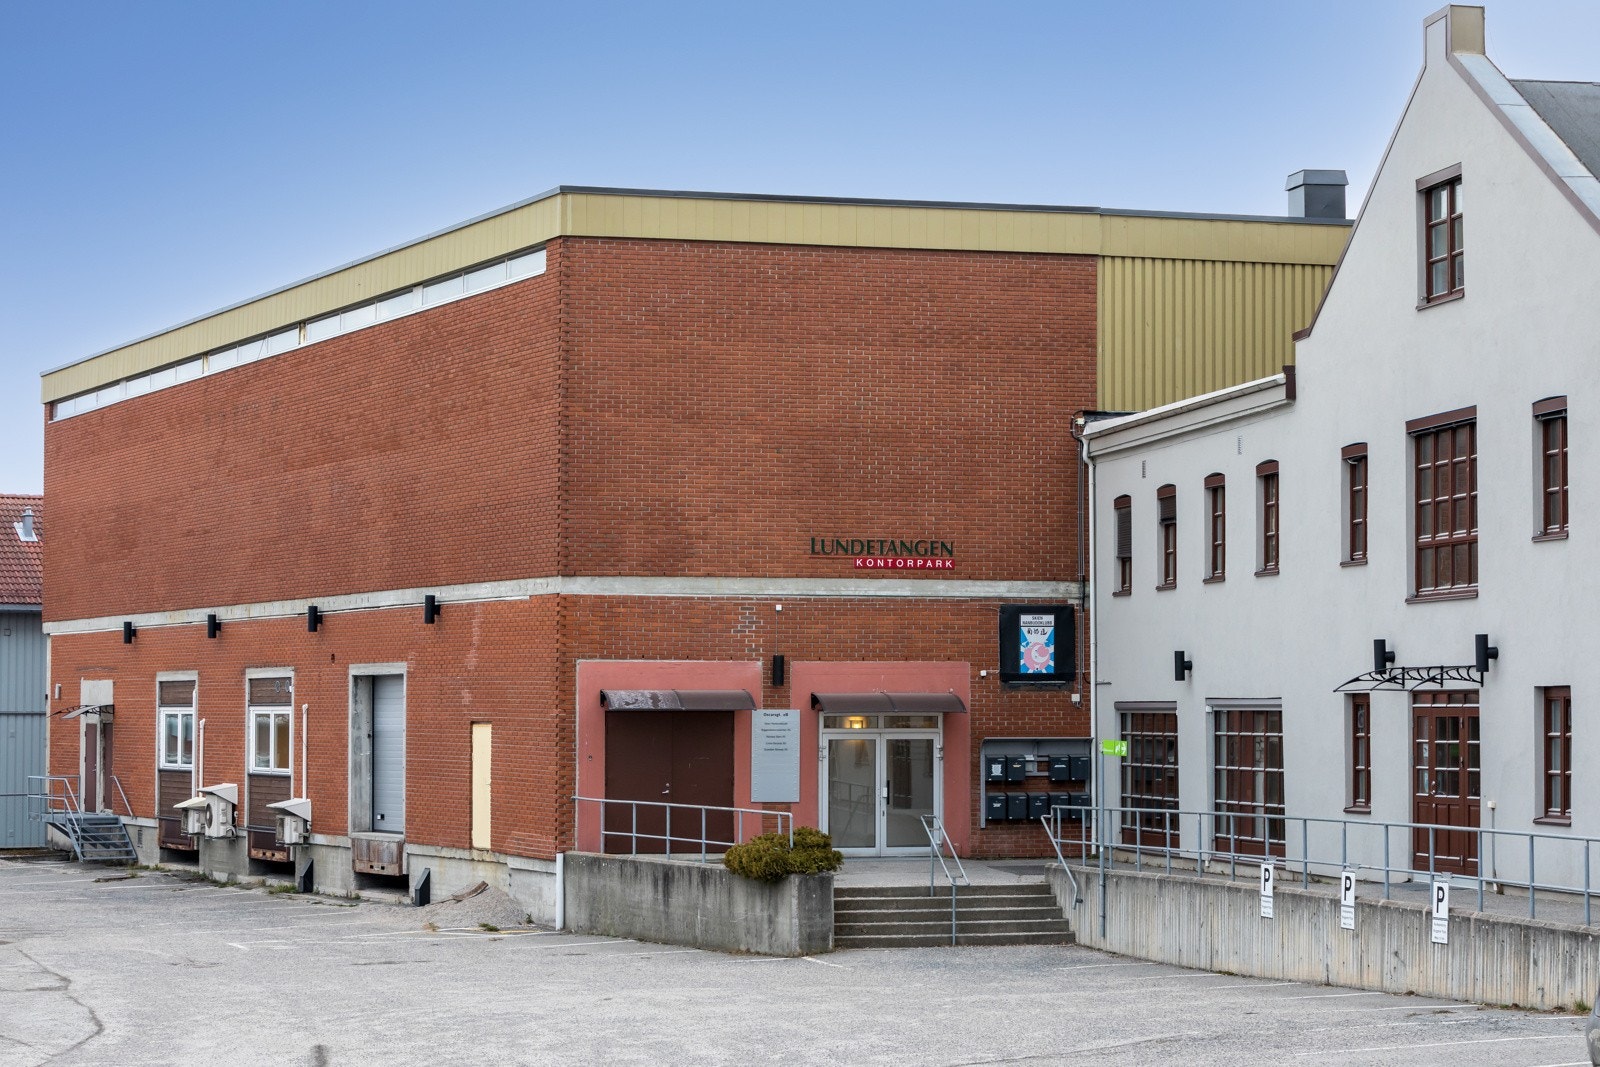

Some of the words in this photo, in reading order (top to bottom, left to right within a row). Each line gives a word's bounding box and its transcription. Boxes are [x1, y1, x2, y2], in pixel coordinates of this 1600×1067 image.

[810, 537, 954, 556] LUNDETANGEN
[856, 558, 953, 568] KONTORPARK
[1263, 867, 1271, 892] P
[1344, 875, 1352, 901] P
[1436, 886, 1445, 913] P
